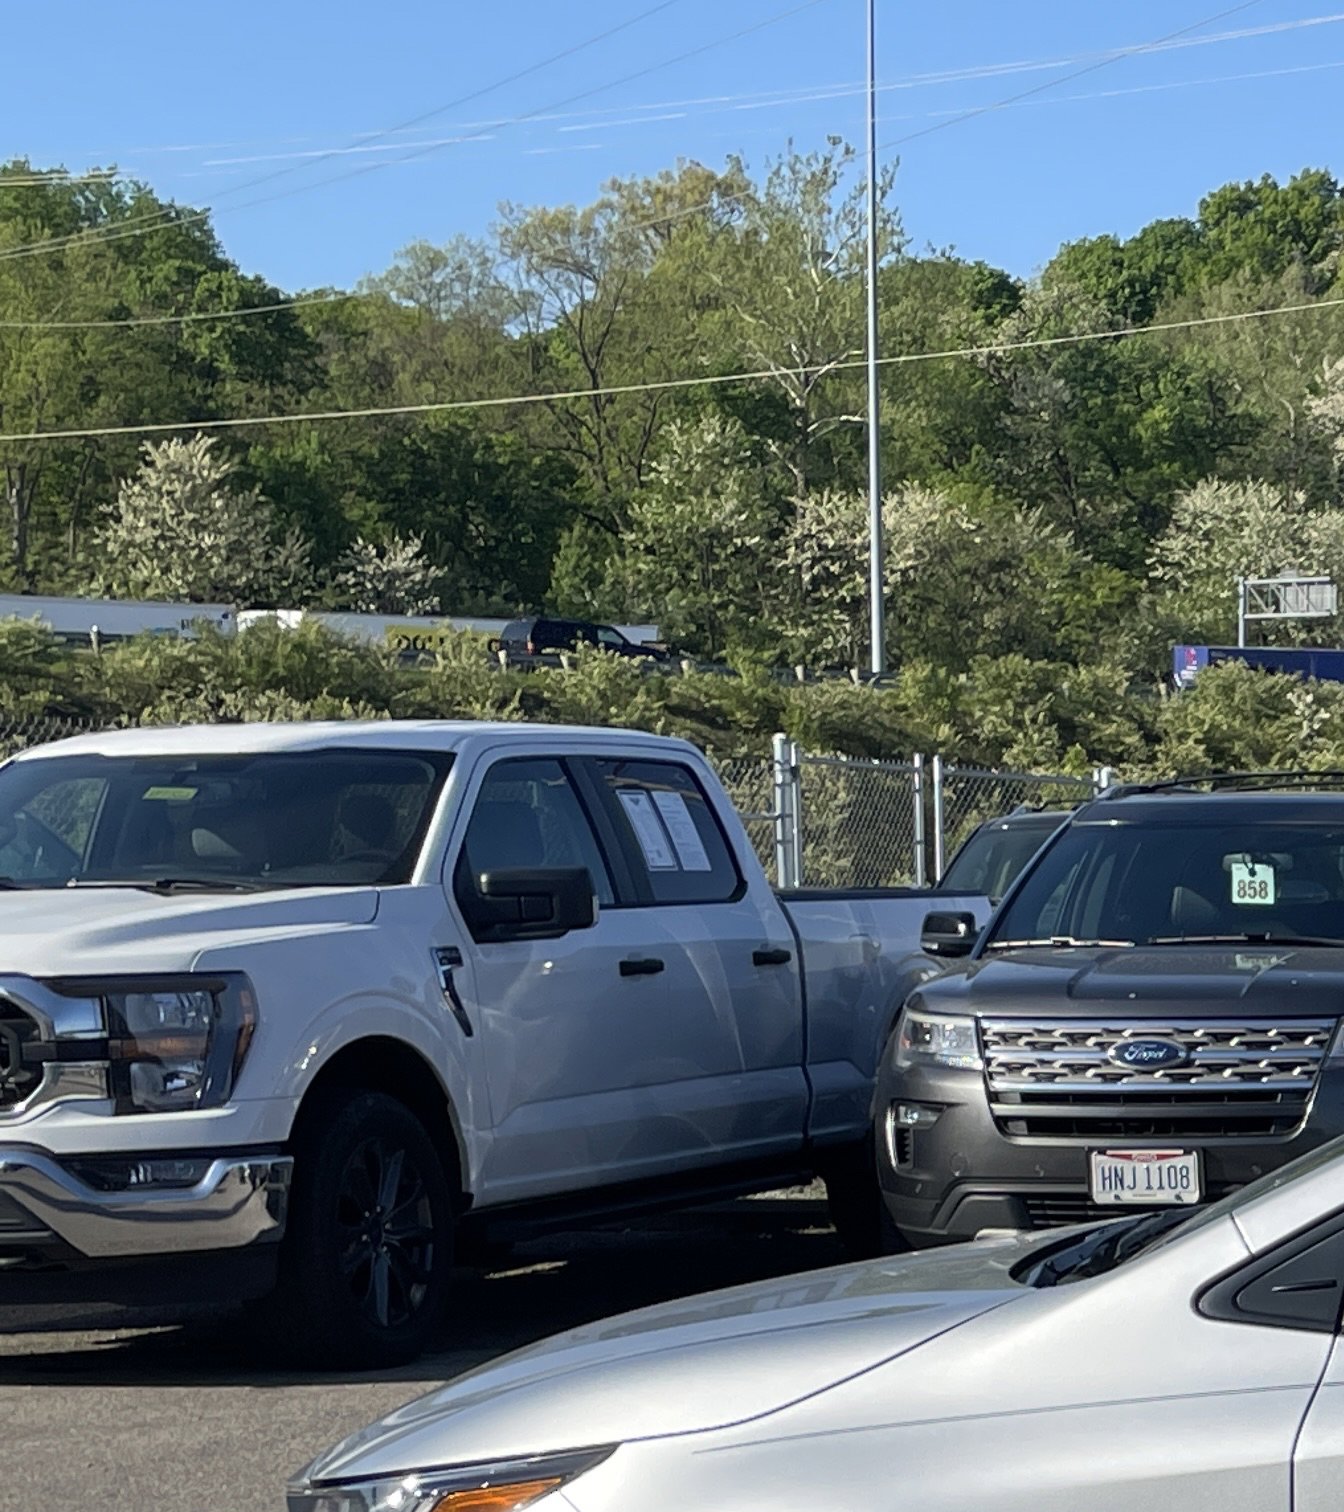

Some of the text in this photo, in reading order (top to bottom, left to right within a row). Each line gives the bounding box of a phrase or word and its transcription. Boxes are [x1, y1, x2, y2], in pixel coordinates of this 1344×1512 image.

[1237, 879, 1268, 899] 858
[1124, 1044, 1167, 1060] Ford
[1101, 1164, 1190, 1191] HNJ 1108
